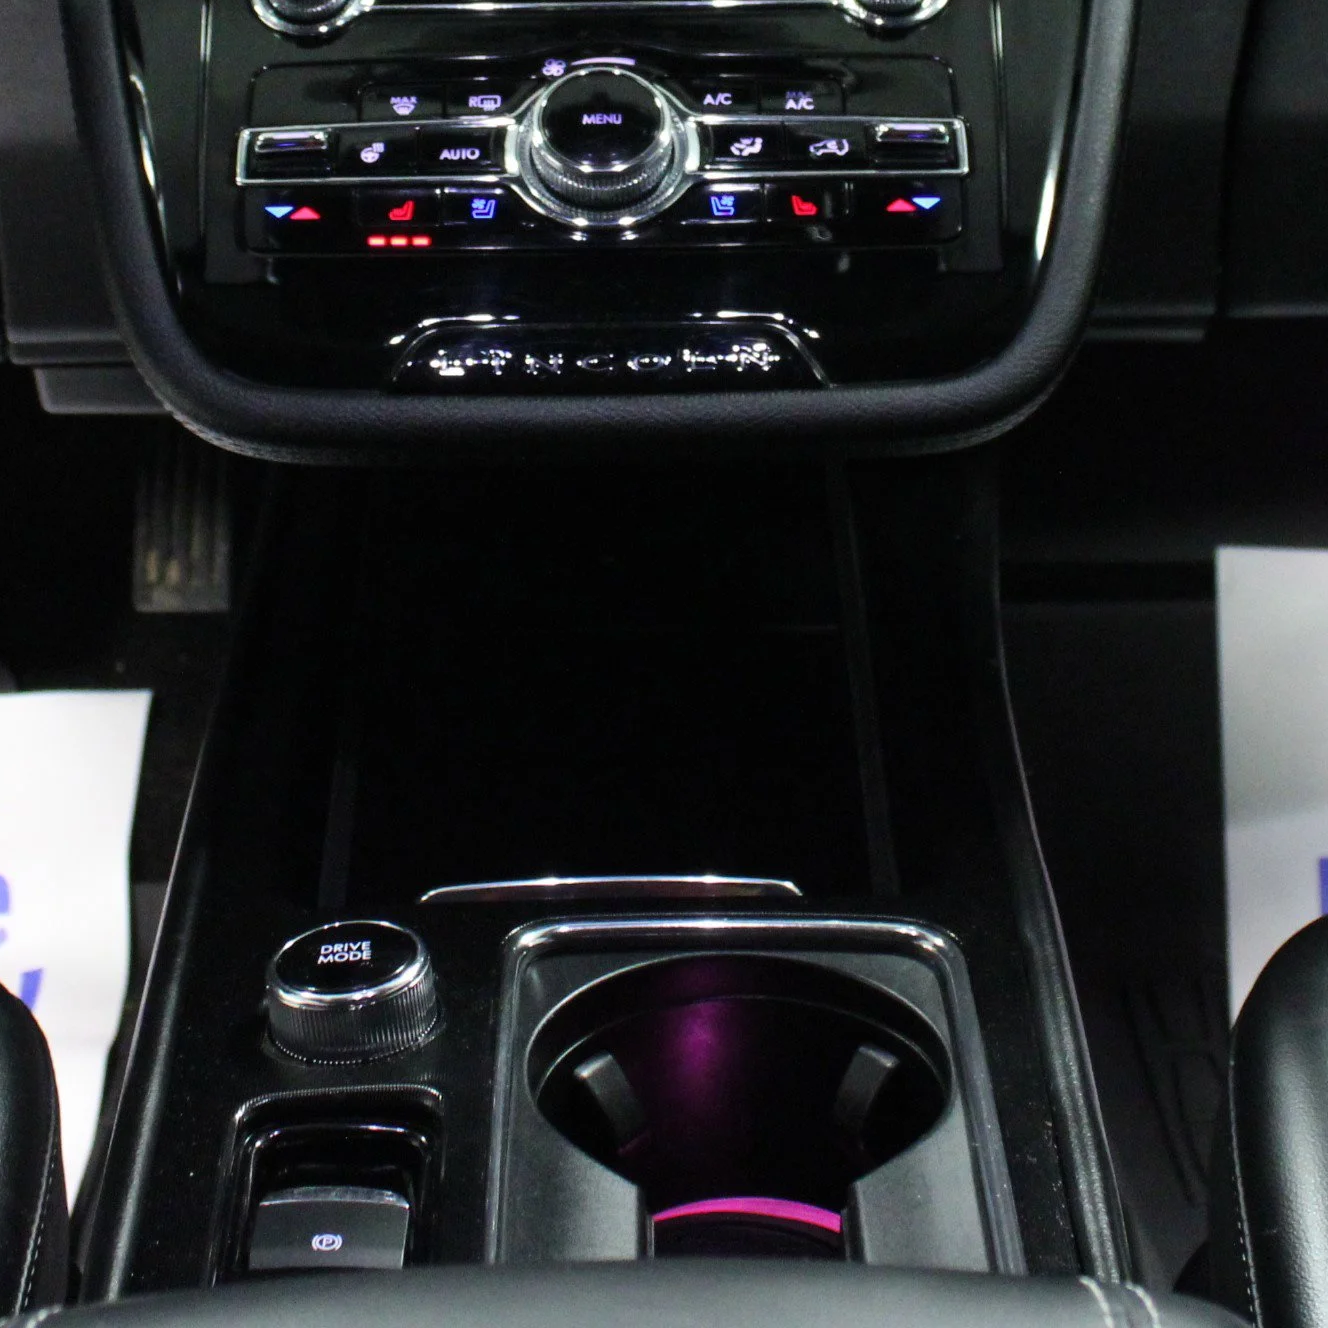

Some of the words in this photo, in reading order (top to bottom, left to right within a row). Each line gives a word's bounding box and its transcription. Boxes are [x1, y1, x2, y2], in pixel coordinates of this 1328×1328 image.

[703, 93, 732, 106] A/C
[785, 97, 814, 110] A/C
[582, 113, 622, 125] MENU
[439, 148, 480, 160] AUTO
[432, 344, 773, 376] LINCOLN
[320, 941, 371, 955] DRIVE
[317, 950, 372, 965] MODE
